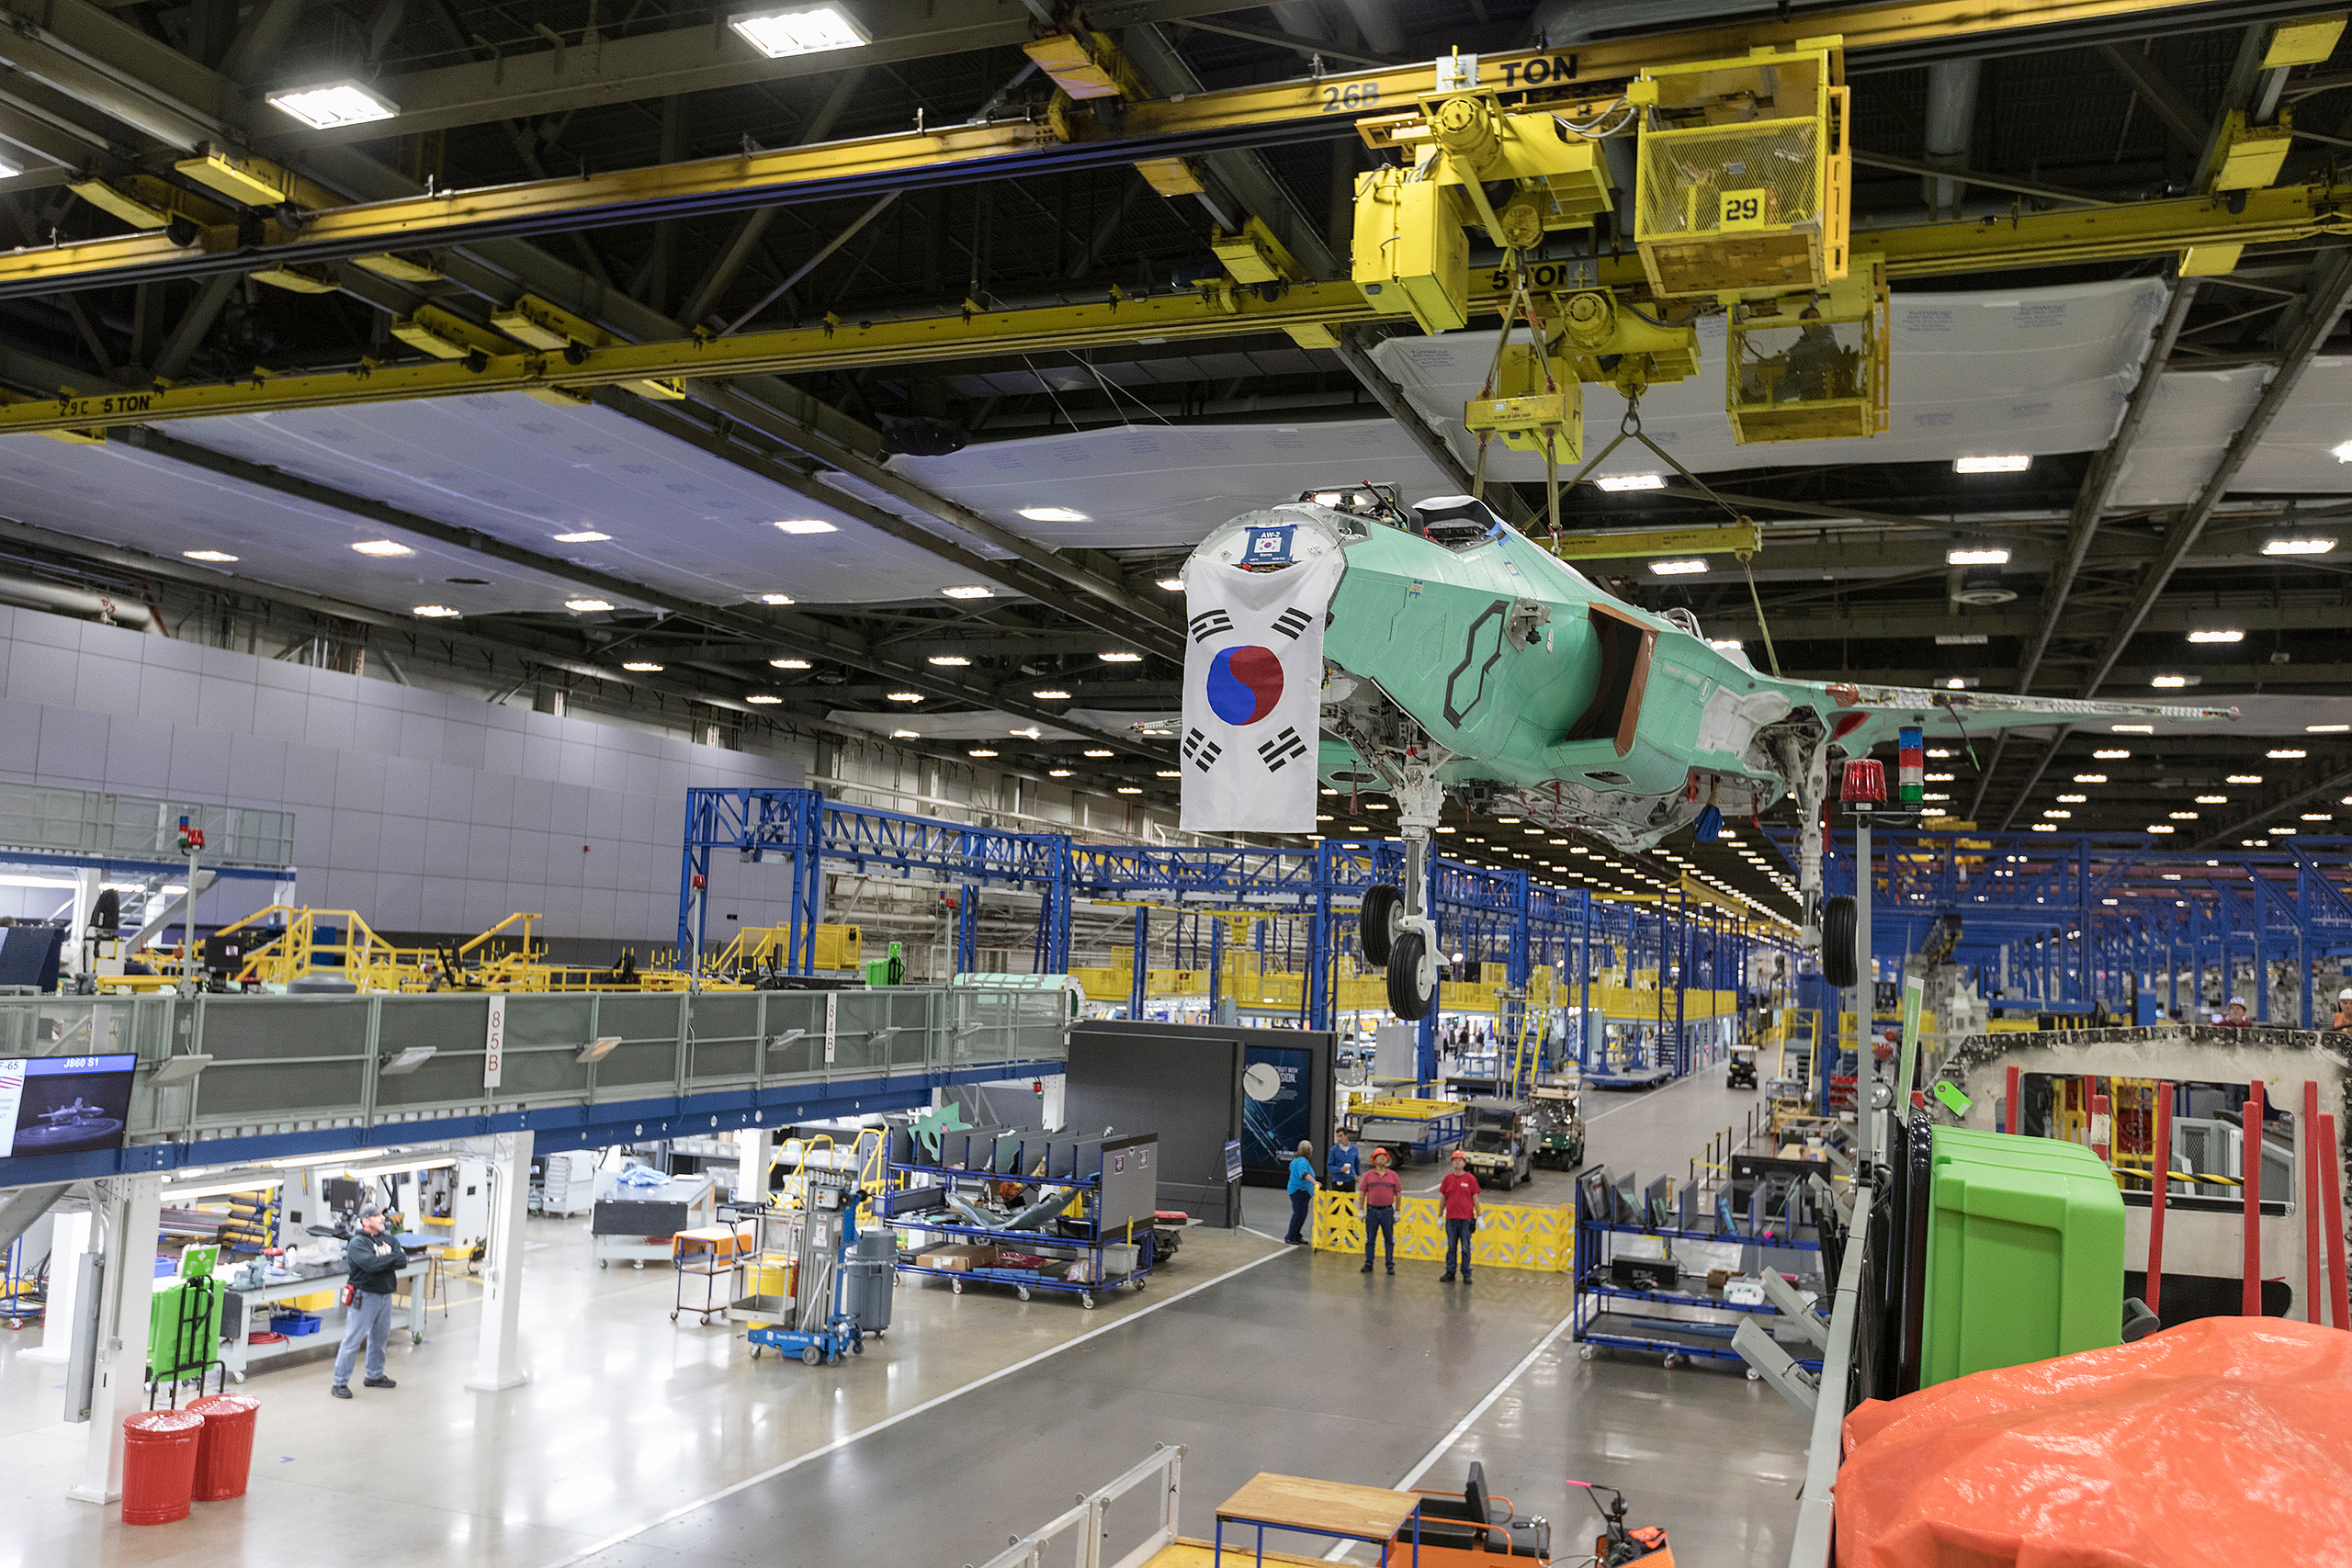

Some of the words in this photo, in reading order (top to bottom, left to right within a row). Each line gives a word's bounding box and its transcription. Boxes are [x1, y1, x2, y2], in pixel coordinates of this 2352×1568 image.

[1323, 82, 1380, 112] 26B
[1499, 53, 1578, 87] TON
[1726, 198, 1758, 220] 29
[103, 398, 114, 413] 5
[118, 395, 150, 412] TON
[488, 1011, 501, 1072] 85B
[827, 1004, 835, 1051] 84B
[63, 1057, 86, 1069] J860
[87, 1057, 99, 1066] S1
